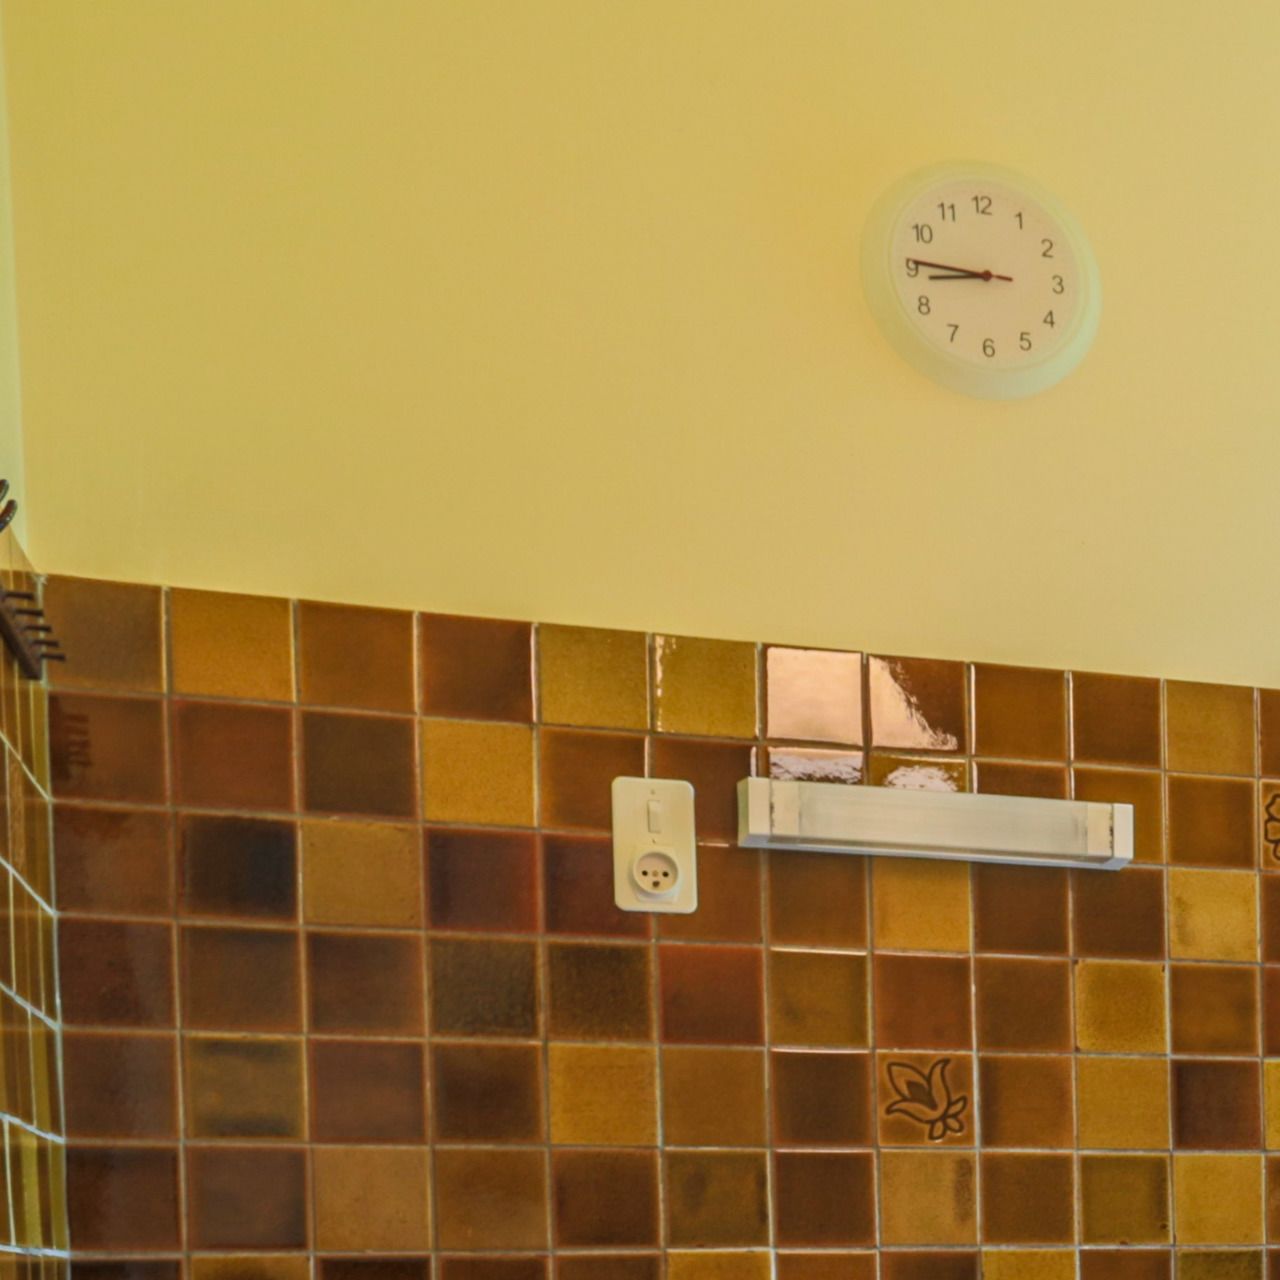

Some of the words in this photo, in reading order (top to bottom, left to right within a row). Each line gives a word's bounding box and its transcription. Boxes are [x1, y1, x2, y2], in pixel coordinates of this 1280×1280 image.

[938, 202, 956, 222] 11
[971, 195, 993, 215] 12
[1015, 212, 1023, 230] 1
[912, 223, 934, 244] 10
[1041, 238, 1054, 258] 2
[905, 258, 920, 278] 9
[1052, 275, 1065, 295] 3
[918, 295, 931, 315] 8
[1043, 310, 1056, 328] 4
[947, 324, 959, 343] 7
[1019, 332, 1032, 351] 5
[982, 338, 996, 358] 6
